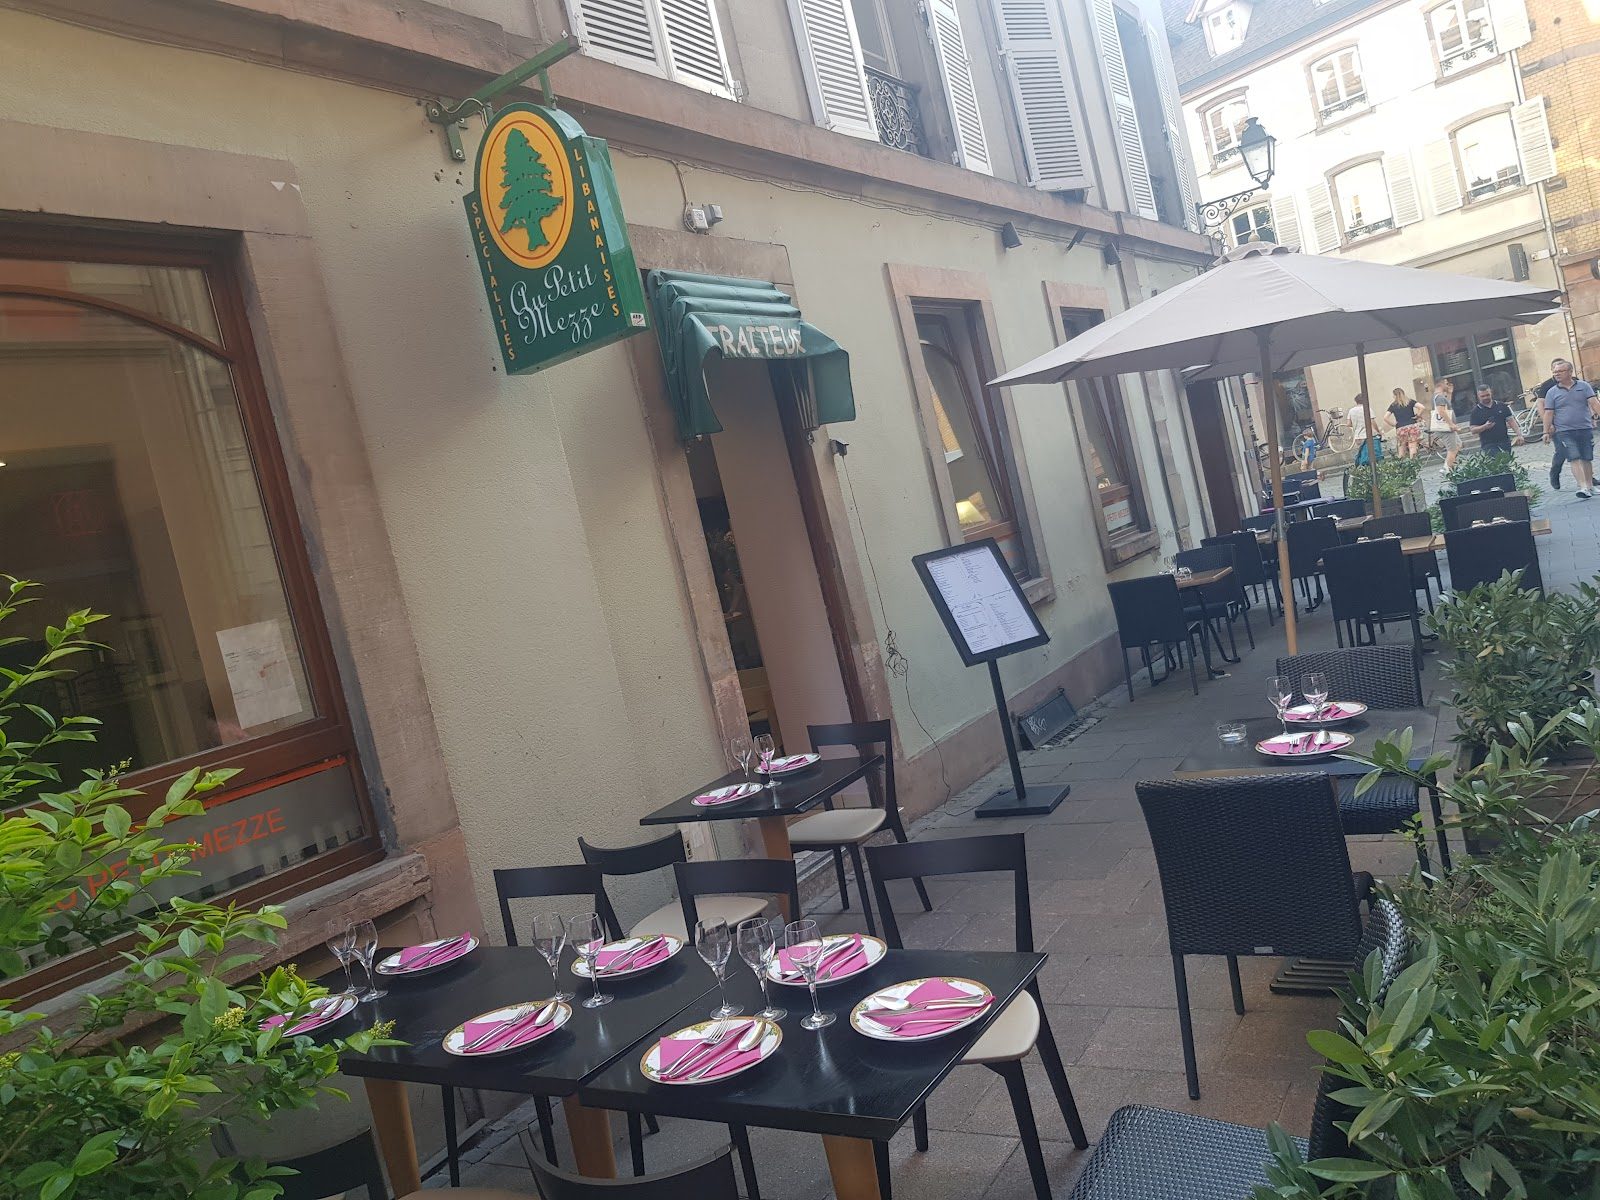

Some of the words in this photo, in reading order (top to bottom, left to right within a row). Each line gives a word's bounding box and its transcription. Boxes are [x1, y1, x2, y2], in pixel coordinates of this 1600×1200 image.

[573, 148, 620, 317] LIBANAISES
[471, 201, 516, 361] SPECIALITES
[510, 280, 547, 315] Au
[544, 264, 597, 301] Petit
[518, 303, 605, 344] Mezze
[706, 324, 806, 358] TRAITEUR
[188, 806, 288, 862] MEZZE
